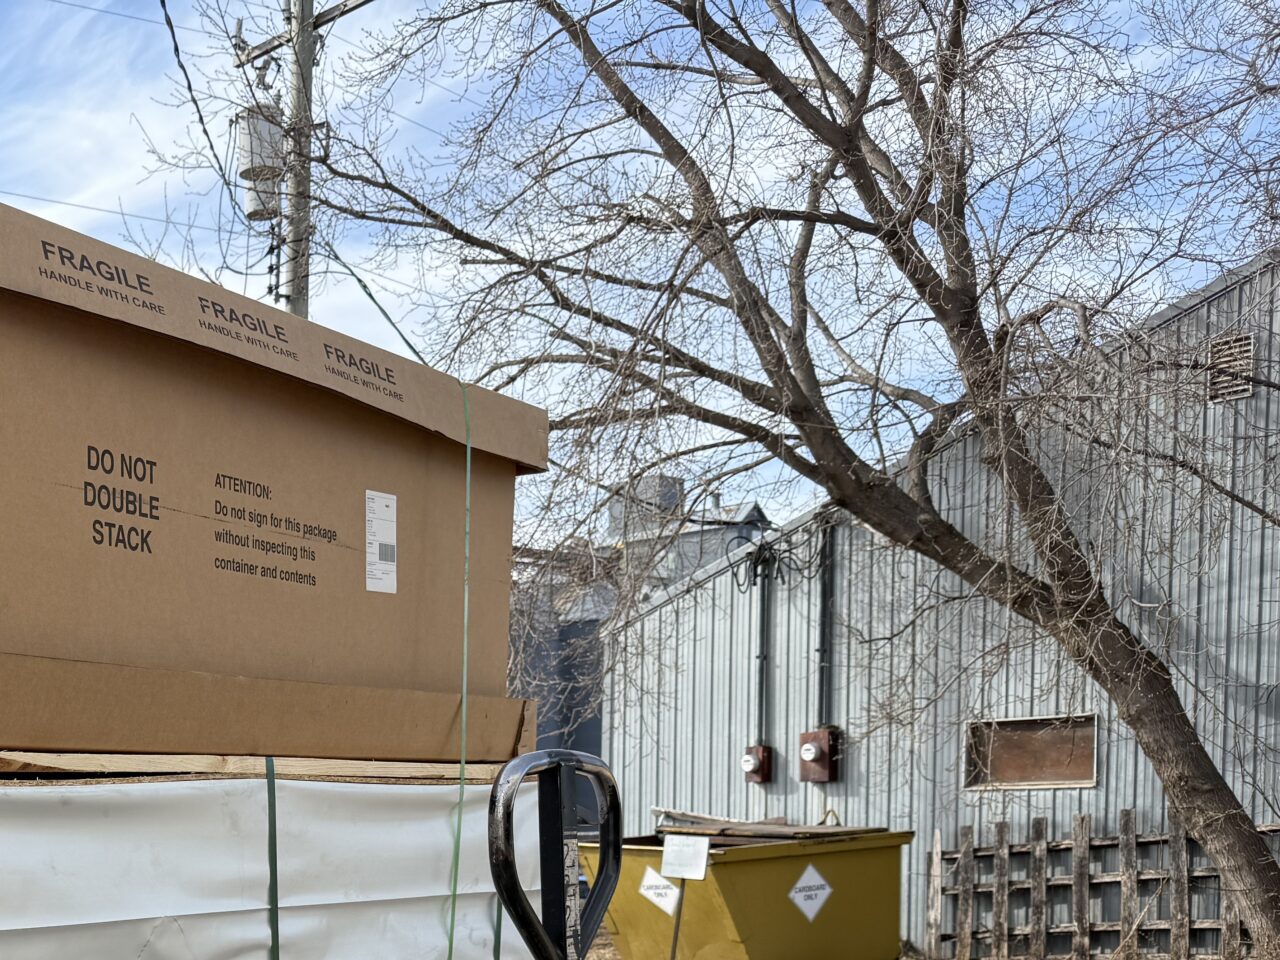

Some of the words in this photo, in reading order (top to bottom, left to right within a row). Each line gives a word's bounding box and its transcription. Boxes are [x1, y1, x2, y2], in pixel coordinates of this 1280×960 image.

[41, 239, 154, 295] FRAGILE
[38, 266, 95, 293] HANDLE
[96, 284, 129, 304] WITH
[132, 296, 167, 316] CARE
[198, 296, 289, 344] FRAGILE
[198, 318, 243, 342] HANDLE
[244, 334, 271, 351] WITH
[272, 345, 300, 362] CARE
[323, 343, 397, 386] FRAGILE
[324, 363, 360, 385] HANDLE
[360, 378, 382, 393] WITH
[382, 387, 405, 403] CARE
[87, 445, 115, 475] DO
[120, 453, 157, 485] NOT
[83, 481, 160, 521] DOUBLE
[214, 472, 272, 501] ATTENTION:
[92, 519, 153, 554] STACK
[214, 500, 228, 517] Do
[230, 507, 246, 521] not
[248, 509, 268, 528] sign
[270, 513, 283, 529] for
[284, 517, 301, 533] this
[302, 523, 337, 544] package
[214, 528, 250, 548] without
[252, 534, 298, 562] inspecting
[300, 545, 316, 561] this
[214, 557, 259, 576] container
[260, 565, 277, 580] and
[279, 568, 317, 587] contents
